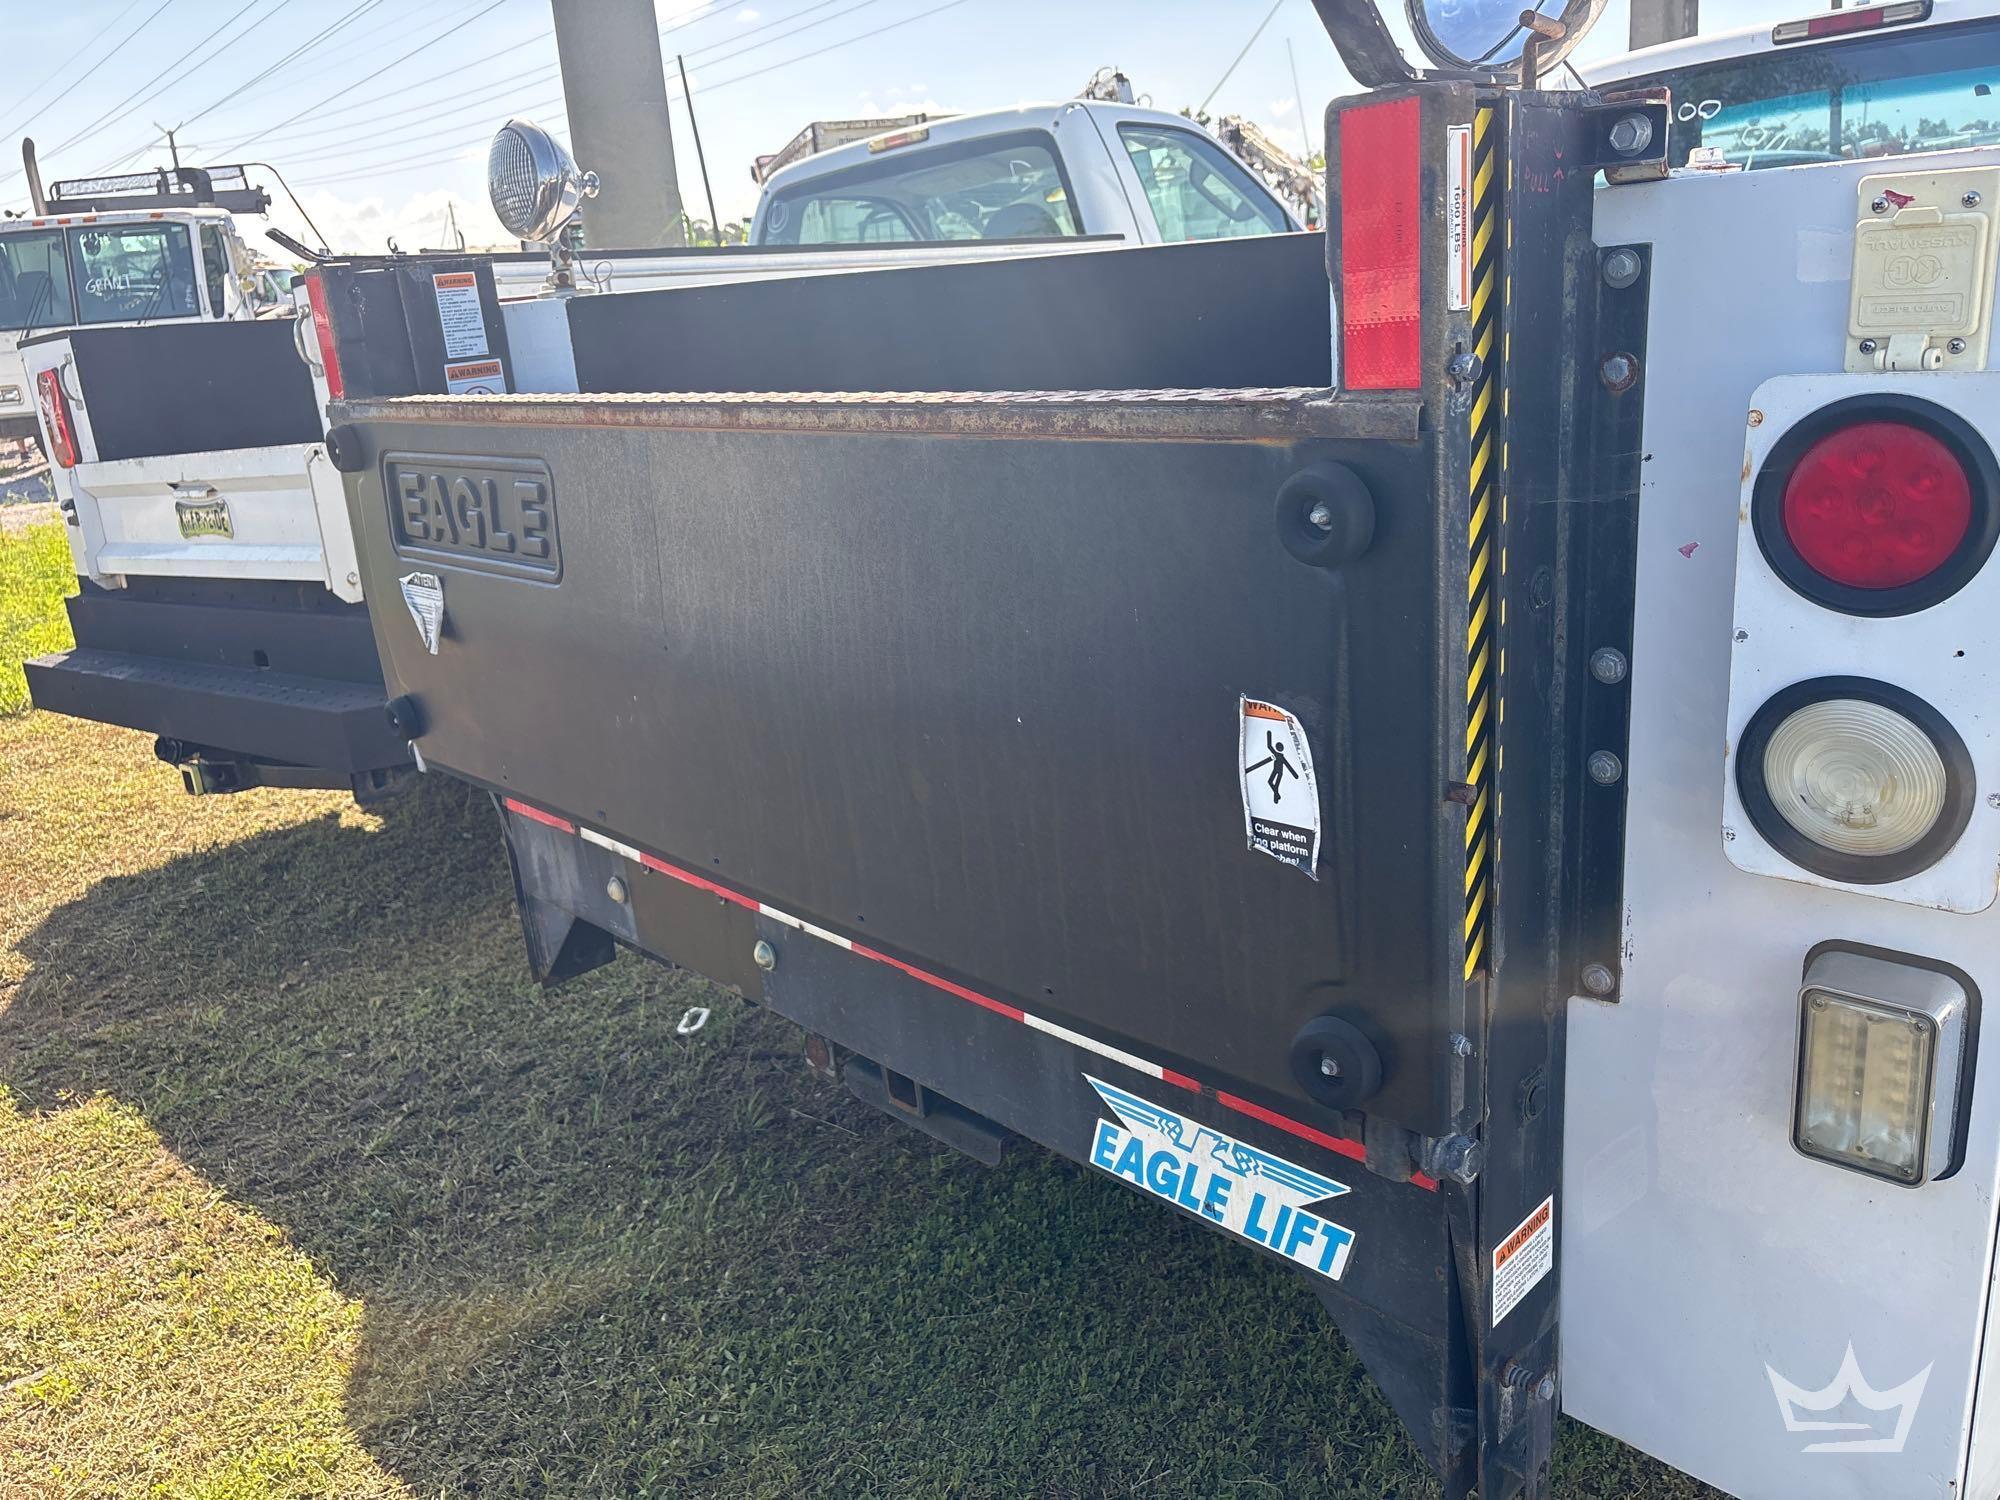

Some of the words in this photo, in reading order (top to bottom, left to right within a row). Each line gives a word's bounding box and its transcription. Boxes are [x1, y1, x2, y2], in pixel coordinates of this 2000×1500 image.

[1453, 185, 1461, 219] 1600
[1453, 223, 1461, 258] LBS.
[1914, 303, 1949, 313] AUTO
[458, 364, 498, 377] WARNING
[400, 471, 549, 558] EAGLE
[1254, 823, 1280, 837] Clear
[1281, 831, 1307, 844] when
[1270, 840, 1309, 857] platform
[1094, 1122, 1233, 1223] EAGLE
[1243, 1192, 1353, 1273] LIFT
[1507, 1207, 1548, 1255] WARNING
